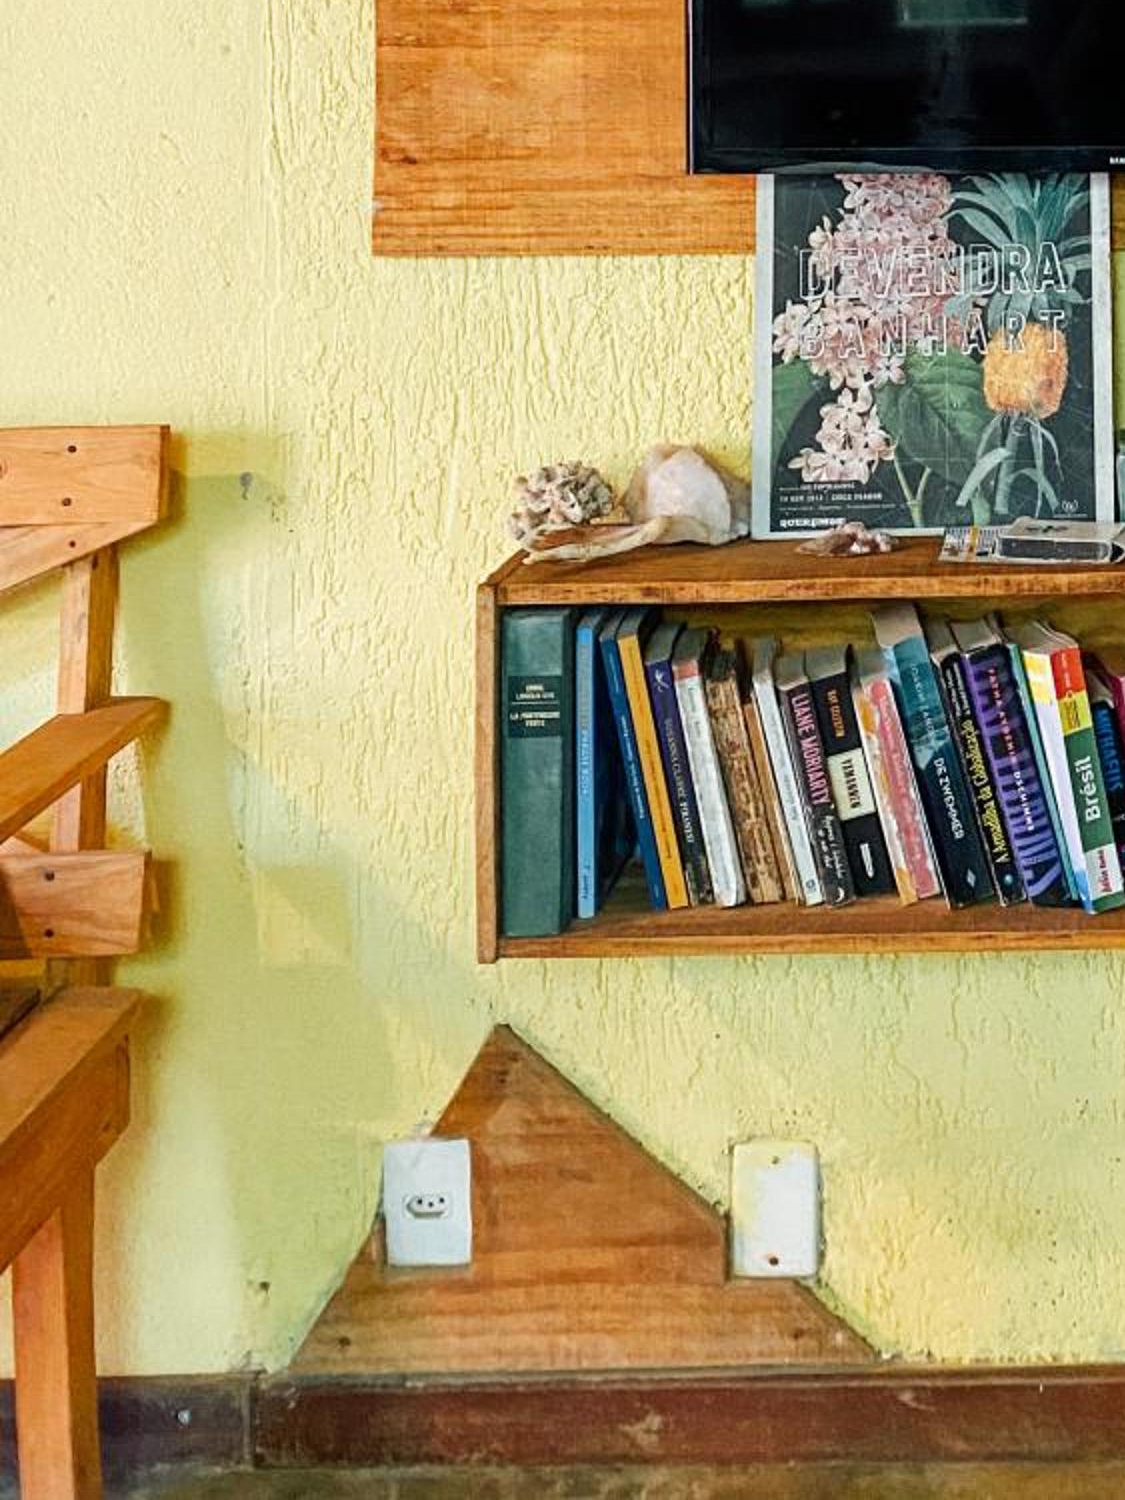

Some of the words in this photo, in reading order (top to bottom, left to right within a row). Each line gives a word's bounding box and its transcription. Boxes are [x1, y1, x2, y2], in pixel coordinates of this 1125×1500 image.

[799, 242, 1068, 301] DEVENDRA
[800, 308, 1067, 359] BANHART
[788, 693, 815, 736] LIANE
[796, 735, 833, 806] MORIARTY
[933, 757, 949, 778] DE
[961, 719, 992, 786] Globalização
[938, 777, 965, 840] ZWEMMER
[976, 786, 993, 801] da
[1084, 756, 1102, 822] Brésil
[979, 800, 1008, 853] Armadilha
